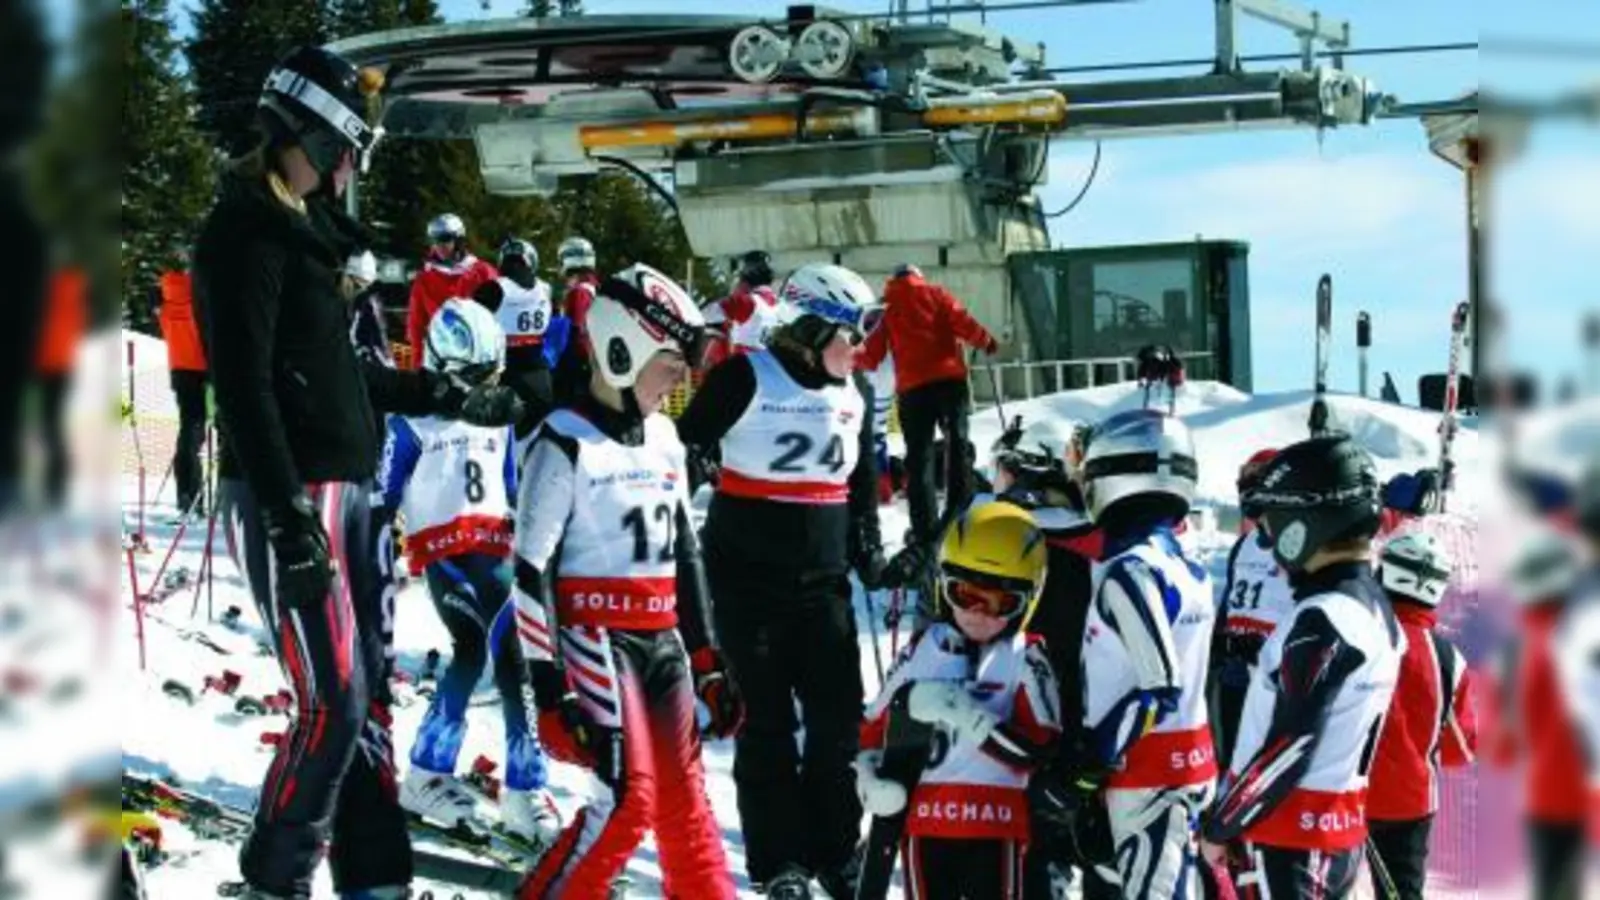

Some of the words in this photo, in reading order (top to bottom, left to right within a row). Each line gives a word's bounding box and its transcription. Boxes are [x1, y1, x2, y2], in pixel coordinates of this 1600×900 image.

[516, 309, 544, 332] 68
[769, 431, 845, 474] 24
[465, 459, 485, 504] 8
[622, 504, 674, 562] 12
[1231, 580, 1263, 609] 31
